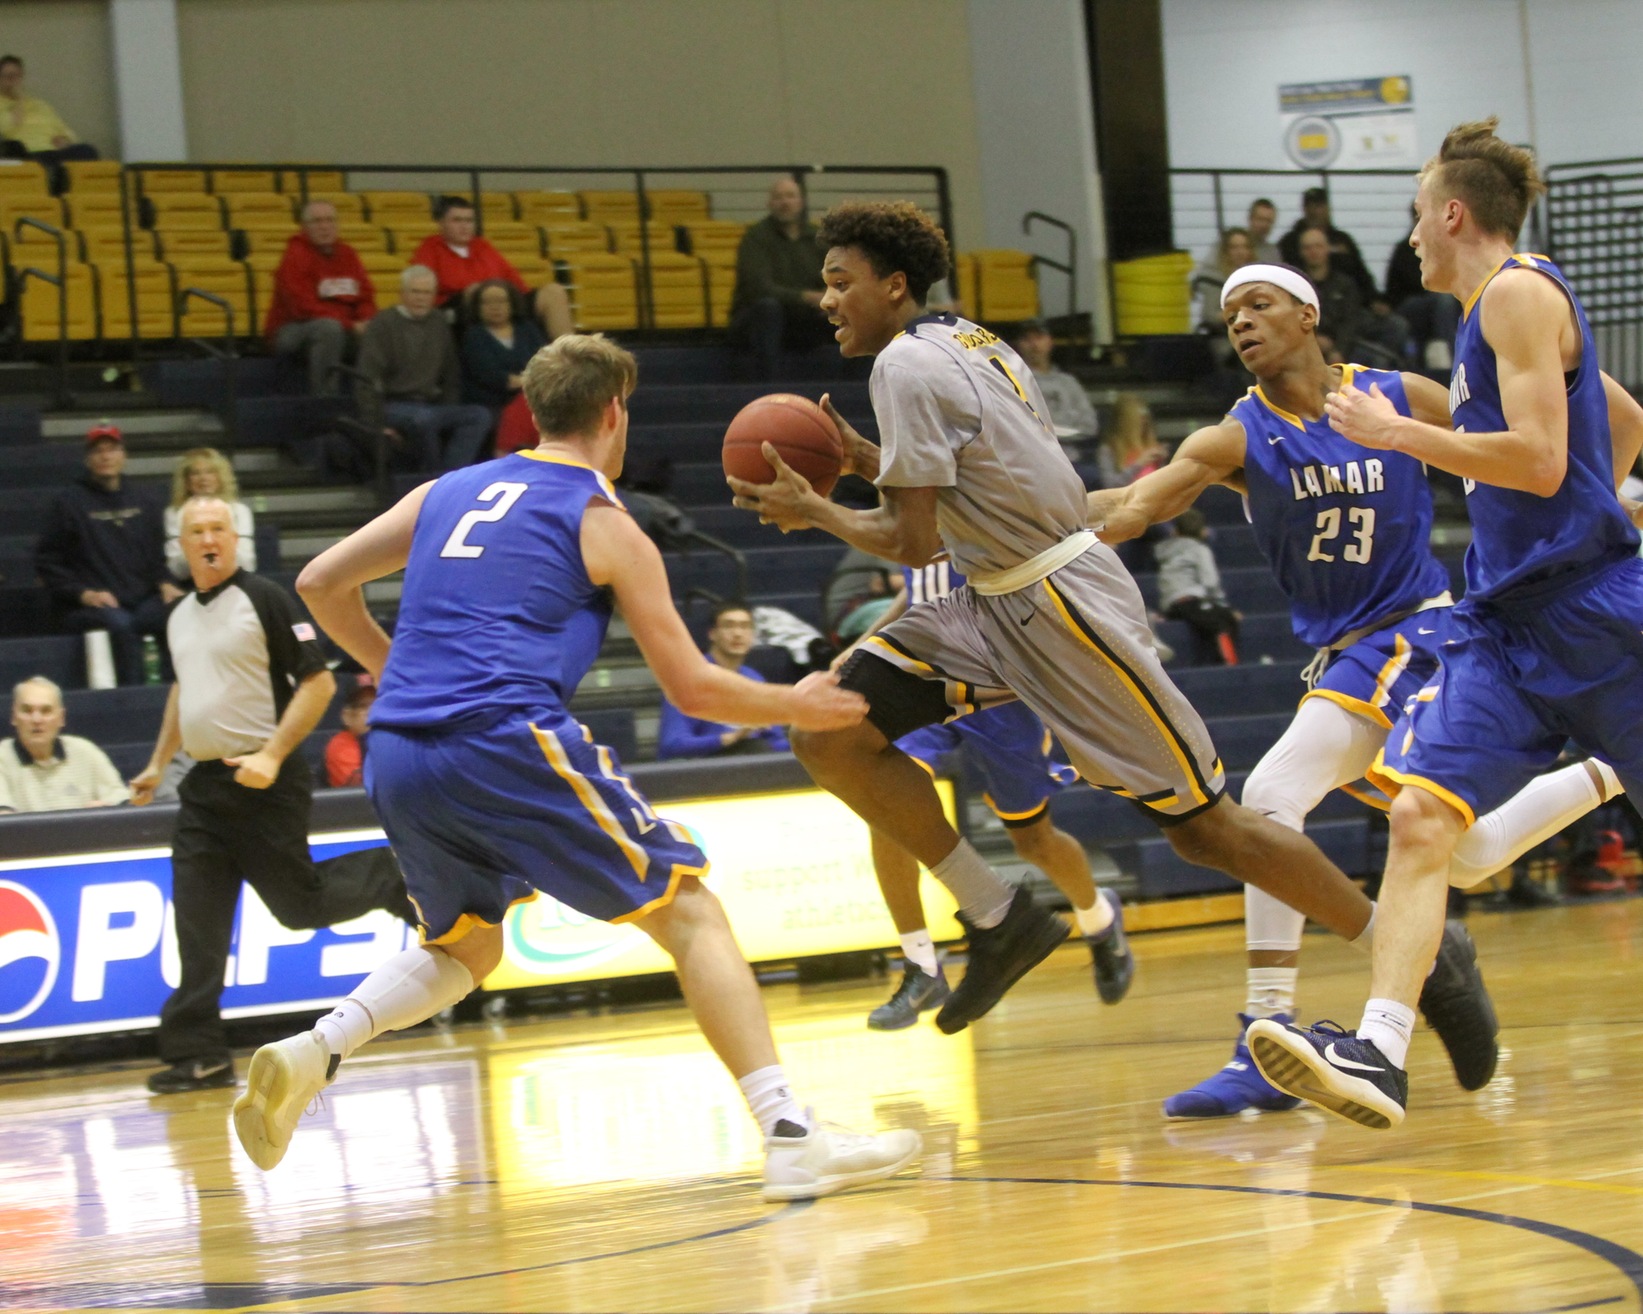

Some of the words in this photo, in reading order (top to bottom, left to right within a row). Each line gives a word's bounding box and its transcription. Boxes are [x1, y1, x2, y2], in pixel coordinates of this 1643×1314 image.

[1289, 458, 1385, 501] LAMAR
[439, 481, 529, 560] 2
[1306, 506, 1377, 566] 23
